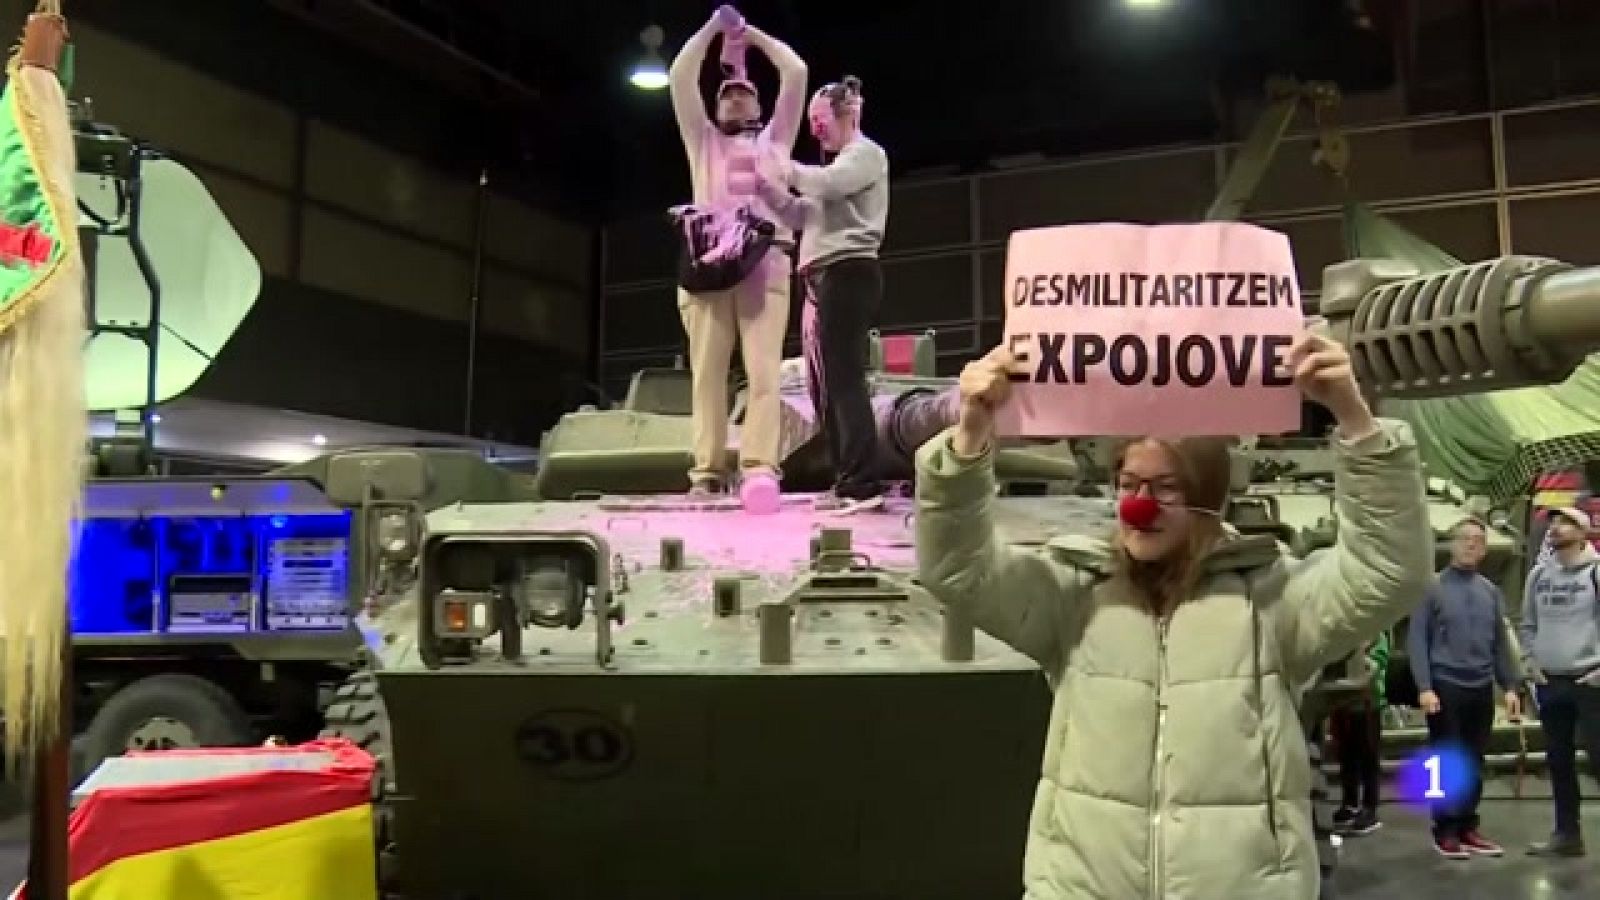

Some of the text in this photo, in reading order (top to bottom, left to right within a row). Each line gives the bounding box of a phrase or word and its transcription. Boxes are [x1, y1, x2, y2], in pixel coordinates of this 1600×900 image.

[1012, 271, 1294, 308] DESMILITARITZEM
[1007, 332, 1294, 388] EXPOJOVE
[517, 723, 621, 765] 30
